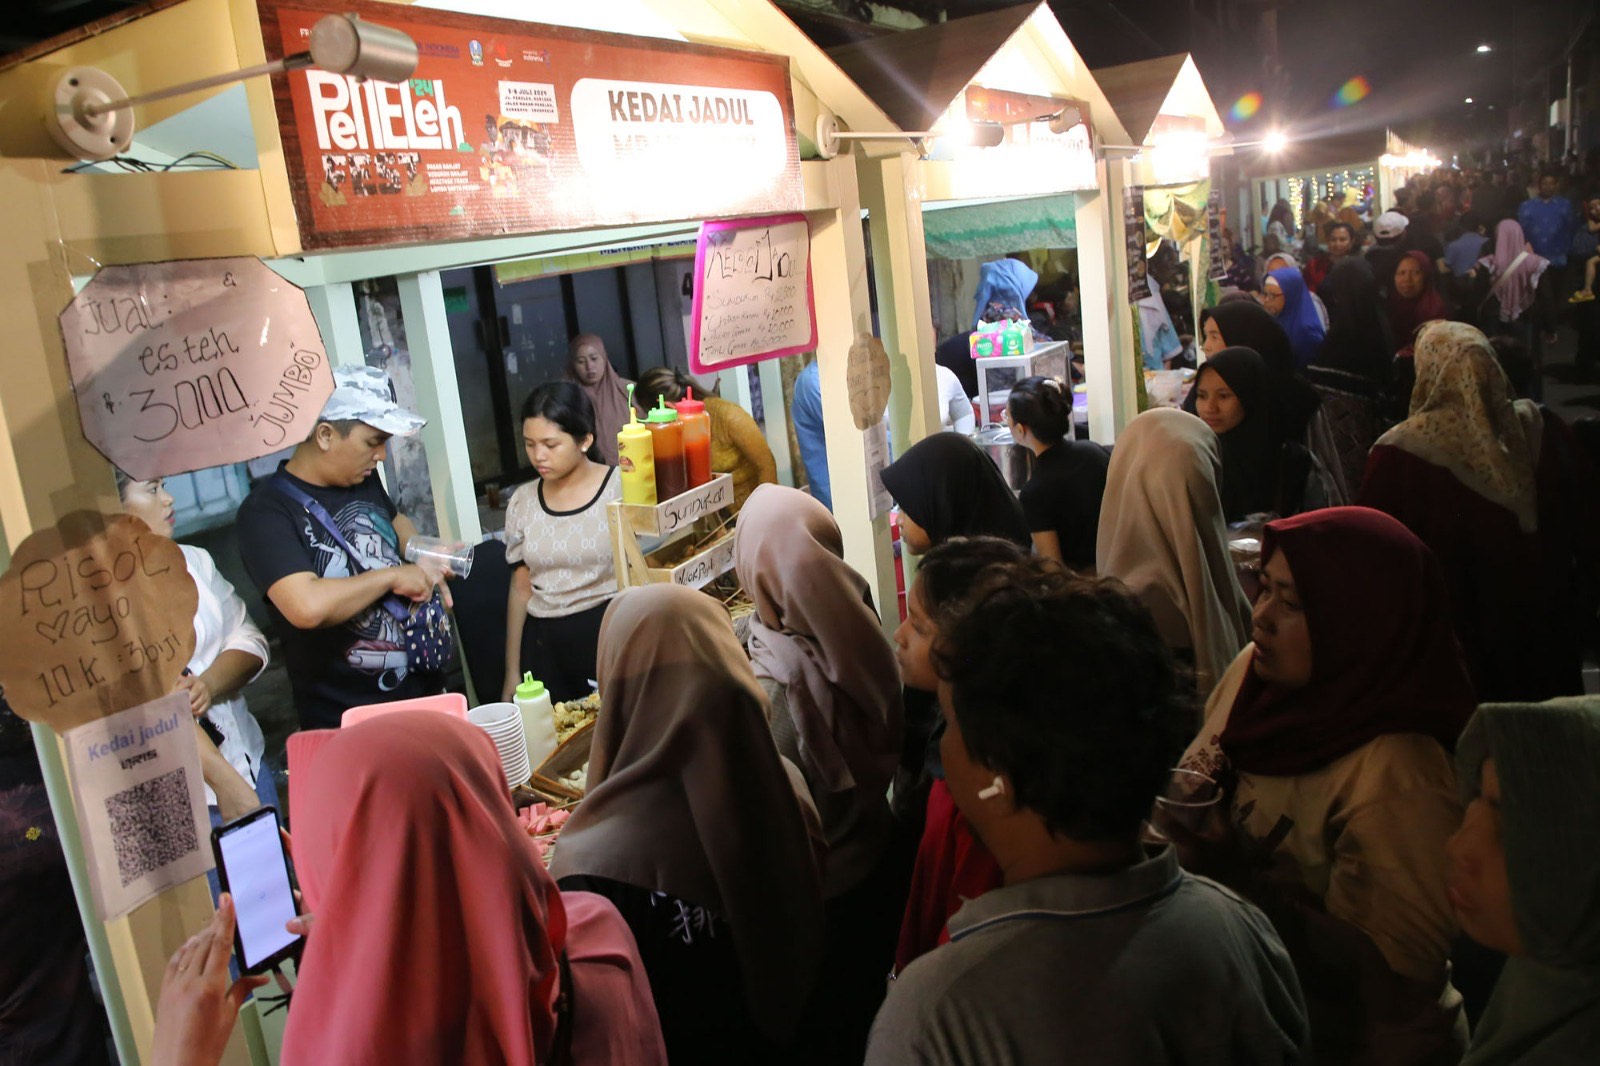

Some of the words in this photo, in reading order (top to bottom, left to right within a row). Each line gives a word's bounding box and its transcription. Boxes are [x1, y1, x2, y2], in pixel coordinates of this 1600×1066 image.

[608, 90, 684, 122] KEDAI
[688, 95, 754, 125] JADUL
[321, 152, 424, 196] FEST
[138, 344, 178, 377] es
[183, 327, 240, 364] teh
[88, 732, 135, 761] Kedai
[140, 713, 180, 746] jadul
[121, 748, 158, 771] QRIS
